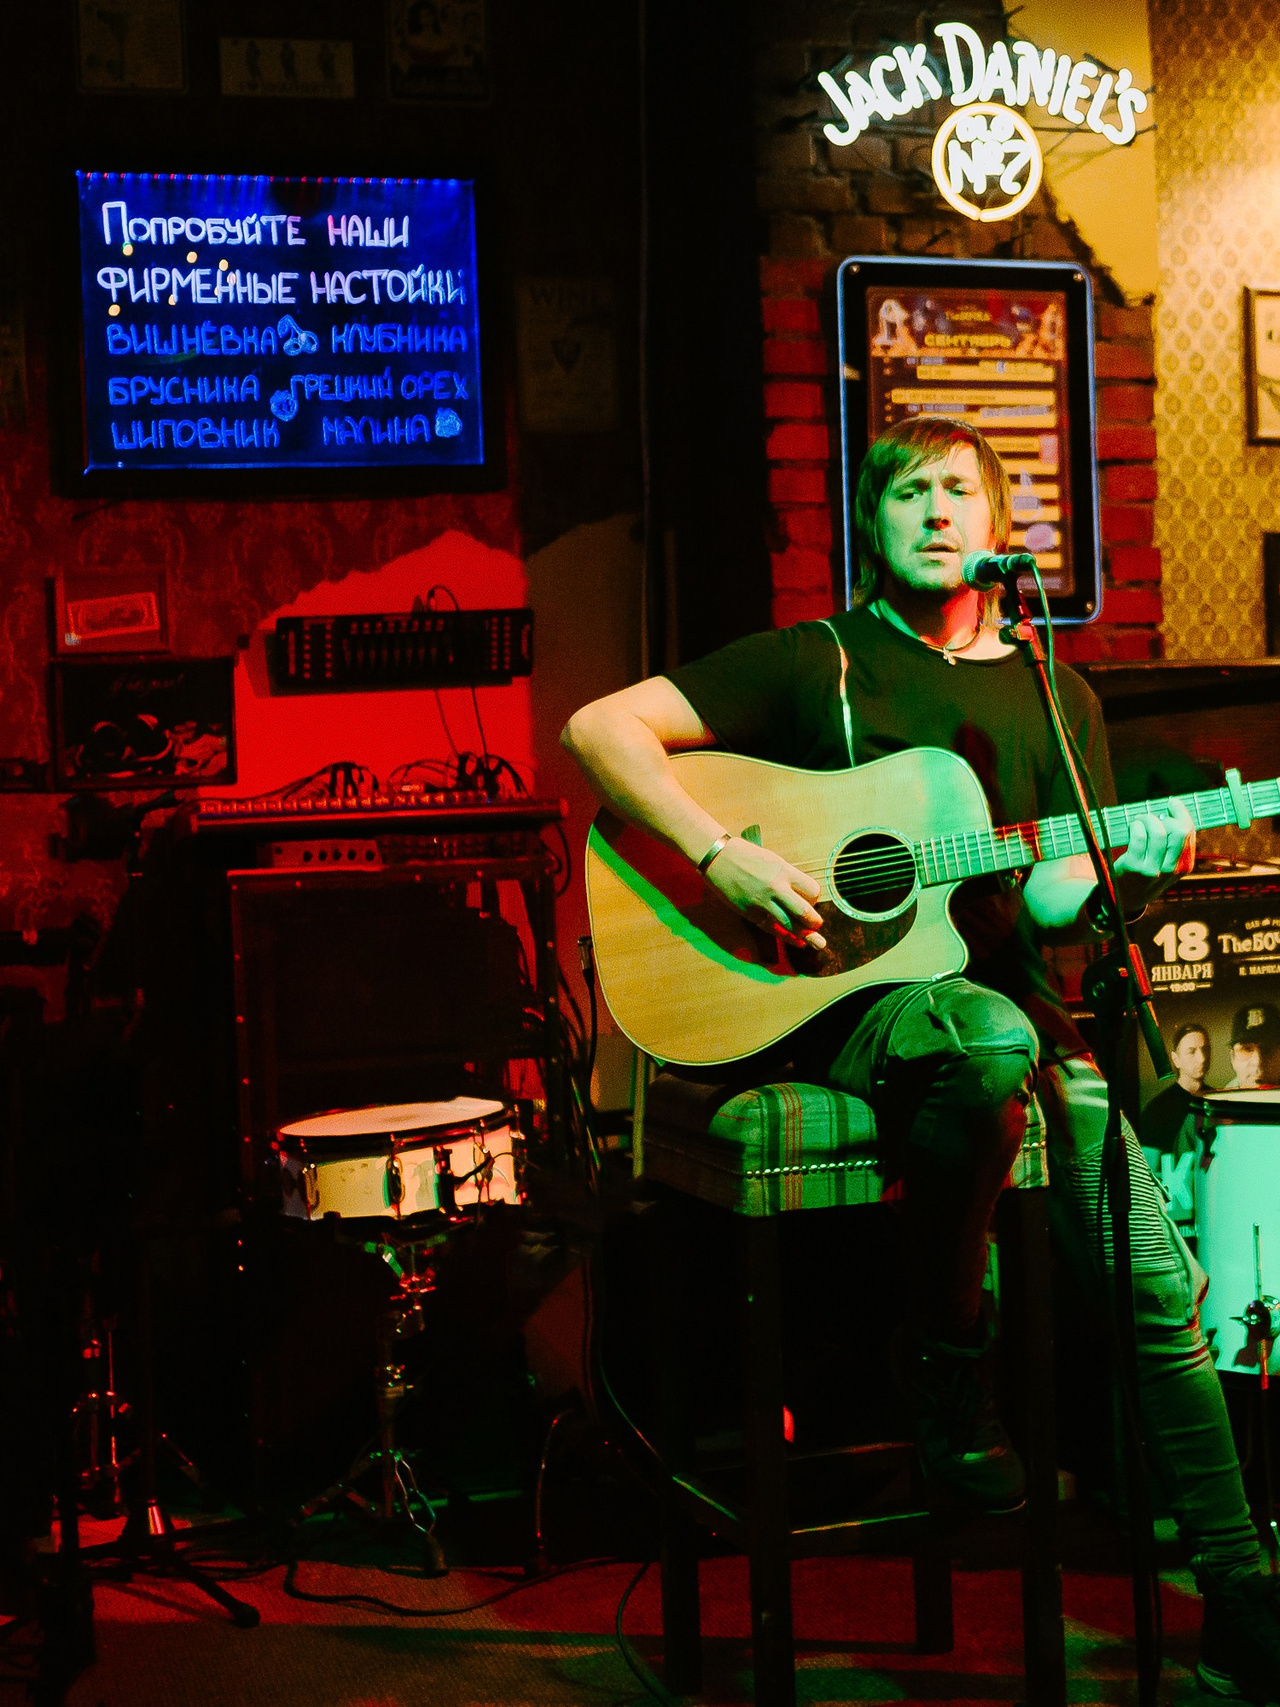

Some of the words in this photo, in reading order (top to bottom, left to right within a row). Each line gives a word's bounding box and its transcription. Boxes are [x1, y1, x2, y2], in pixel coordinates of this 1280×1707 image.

[817, 43, 942, 146] JACK
[102, 201, 306, 246] ПОПРОБУЙТЕ
[327, 214, 409, 247] НАШИ
[96, 267, 299, 304] ФИРМЕННЫЕ
[310, 264, 466, 305] НАСТОЙКИ
[331, 322, 468, 354] КЛУБНИКА
[108, 374, 259, 405] БРУСНИКА
[290, 366, 393, 402] ГРЕЦКИЙ
[401, 372, 469, 400] ОРЕХ
[111, 417, 280, 450] ШИПОВНИК
[322, 416, 431, 446] МАЛИНА
[1153, 921, 1210, 962] 18
[1151, 963, 1214, 982] ЯНВАРЯ
